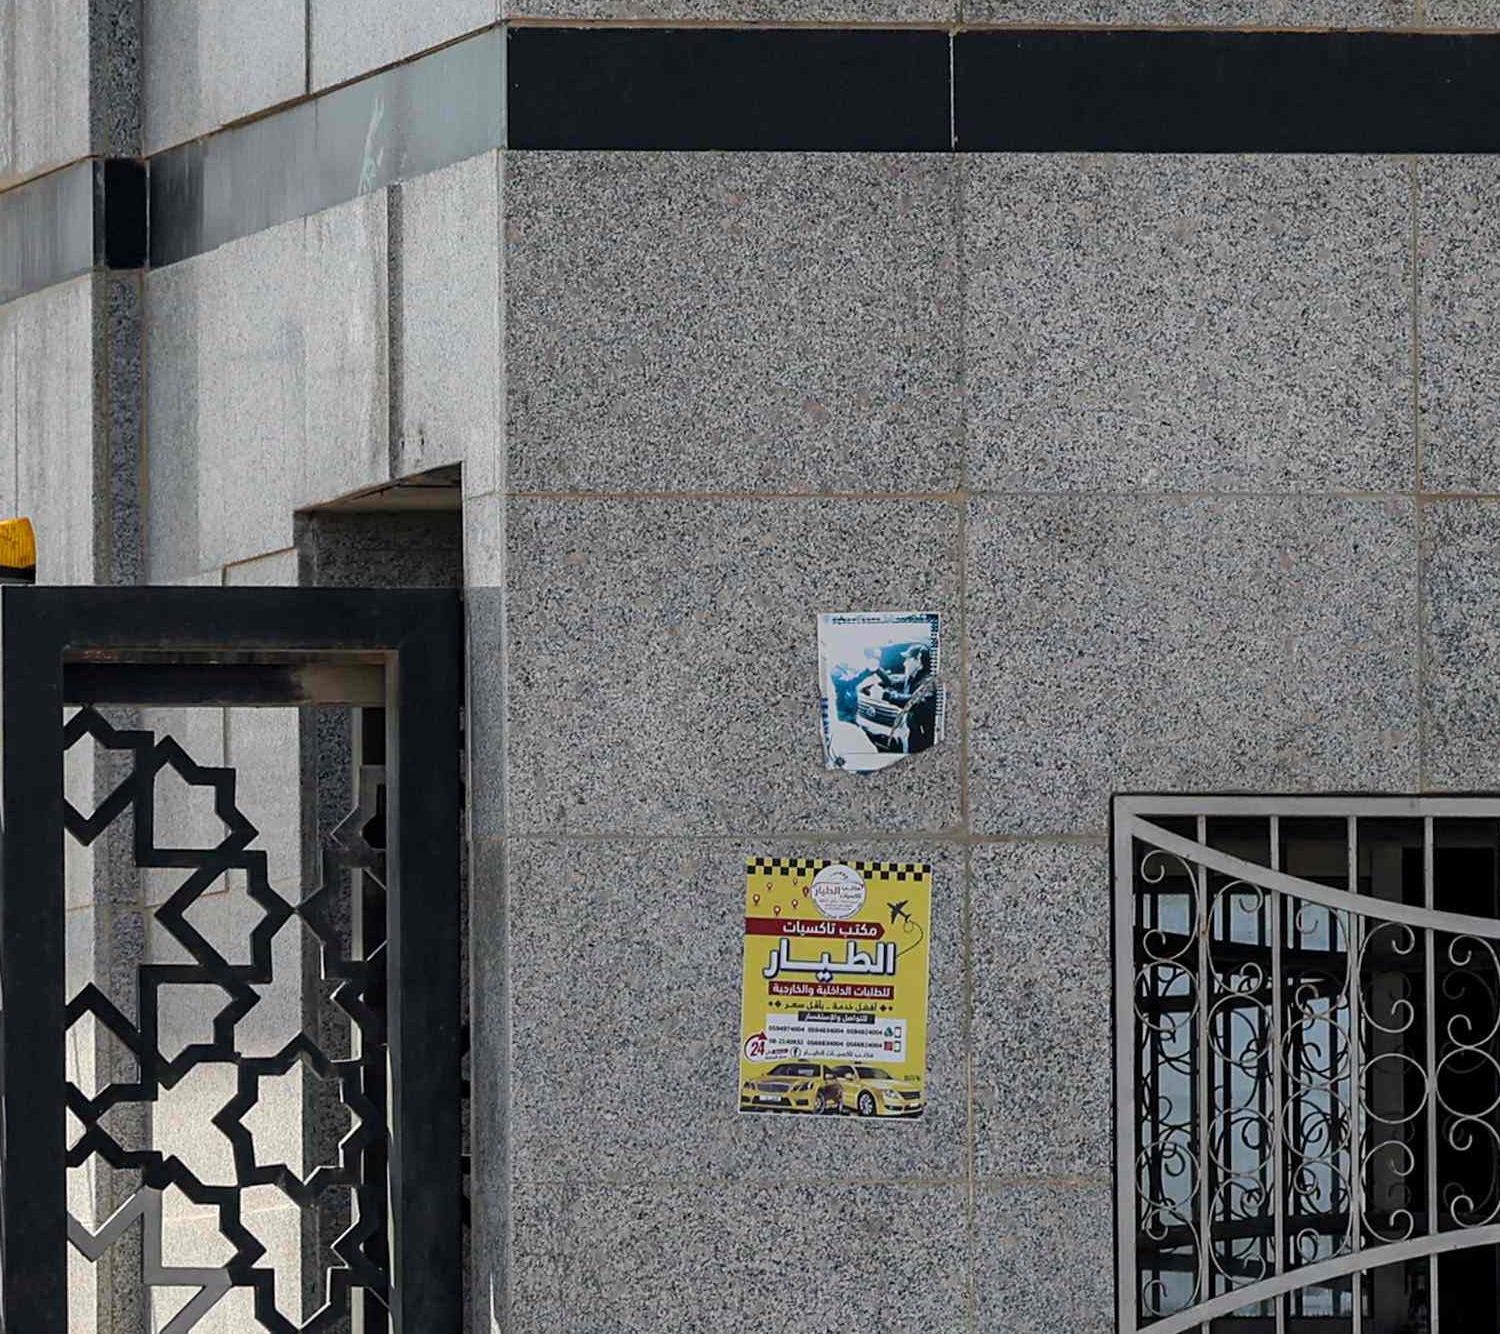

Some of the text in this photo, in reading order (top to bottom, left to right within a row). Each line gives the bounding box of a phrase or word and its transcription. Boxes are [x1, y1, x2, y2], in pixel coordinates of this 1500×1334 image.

[782, 921, 878, 938] مكتب تاكسيات
[762, 937, 897, 982] الطيار
[771, 983, 891, 998] للطلبات الداخلية والخارجية
[749, 1041, 765, 1057] 24
